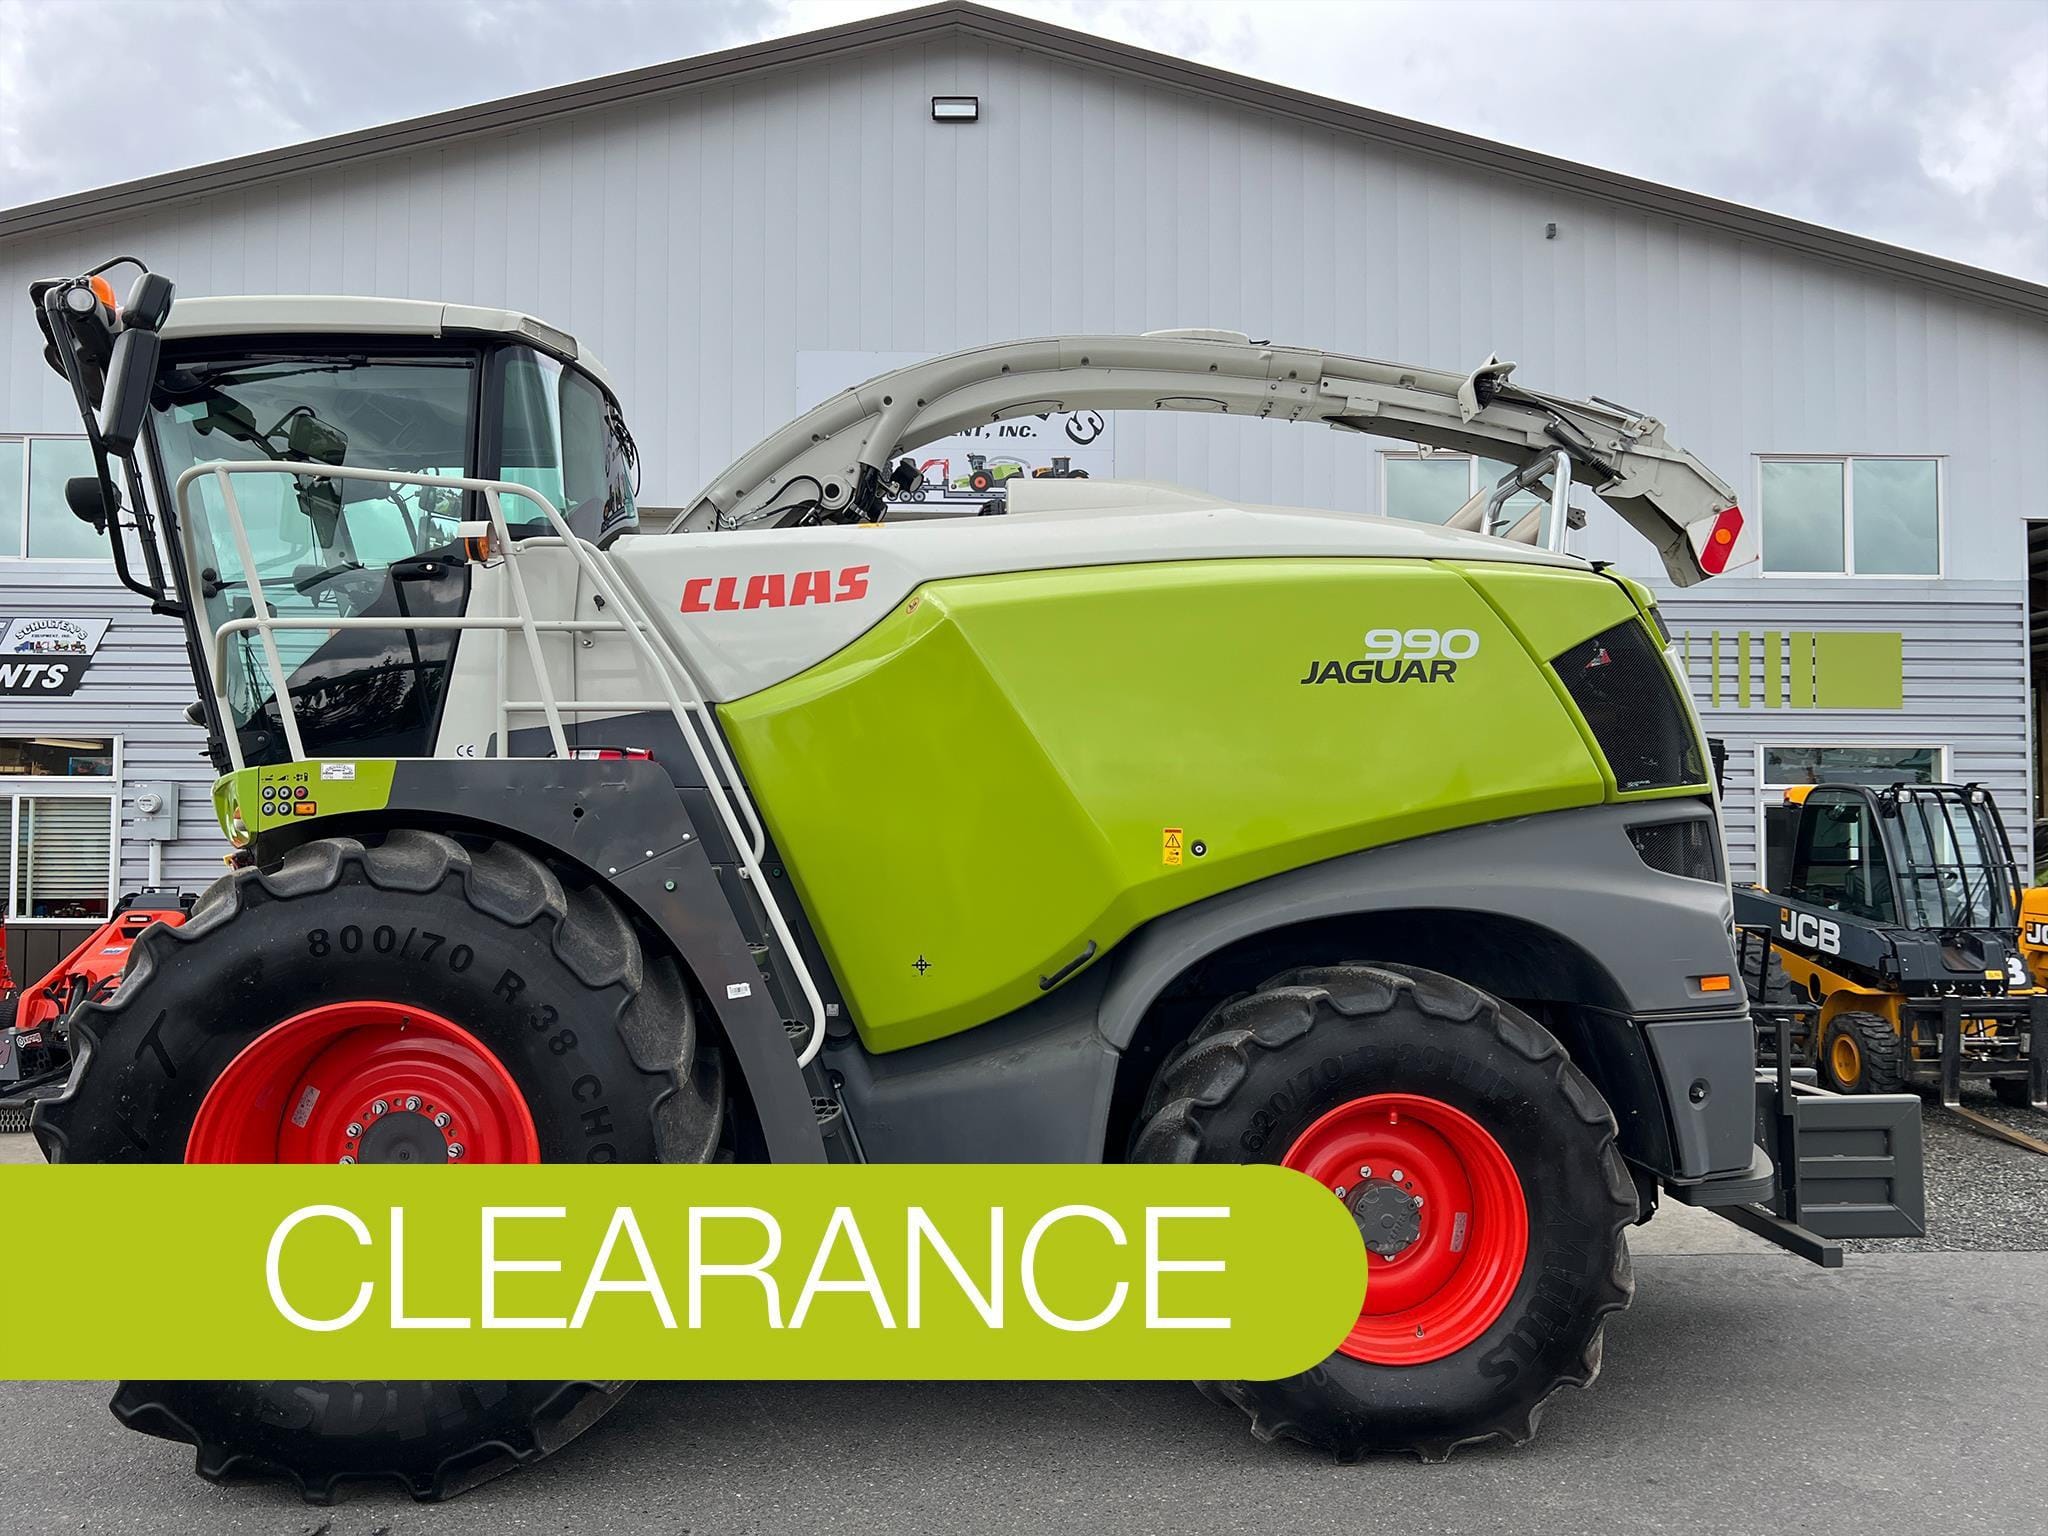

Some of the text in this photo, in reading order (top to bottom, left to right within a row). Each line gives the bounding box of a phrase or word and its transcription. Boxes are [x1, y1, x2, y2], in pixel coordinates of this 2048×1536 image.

[999, 425, 1037, 438] INC.
[680, 564, 870, 613] CLAAS
[15, 619, 88, 640] SCHOLTEN'S
[1364, 628, 1480, 660] 990
[1300, 660, 1457, 684] JAGUAR
[1780, 909, 1841, 955] JCB
[306, 924, 475, 974] 800/70
[492, 968, 527, 1004] R
[529, 1004, 578, 1057] 38
